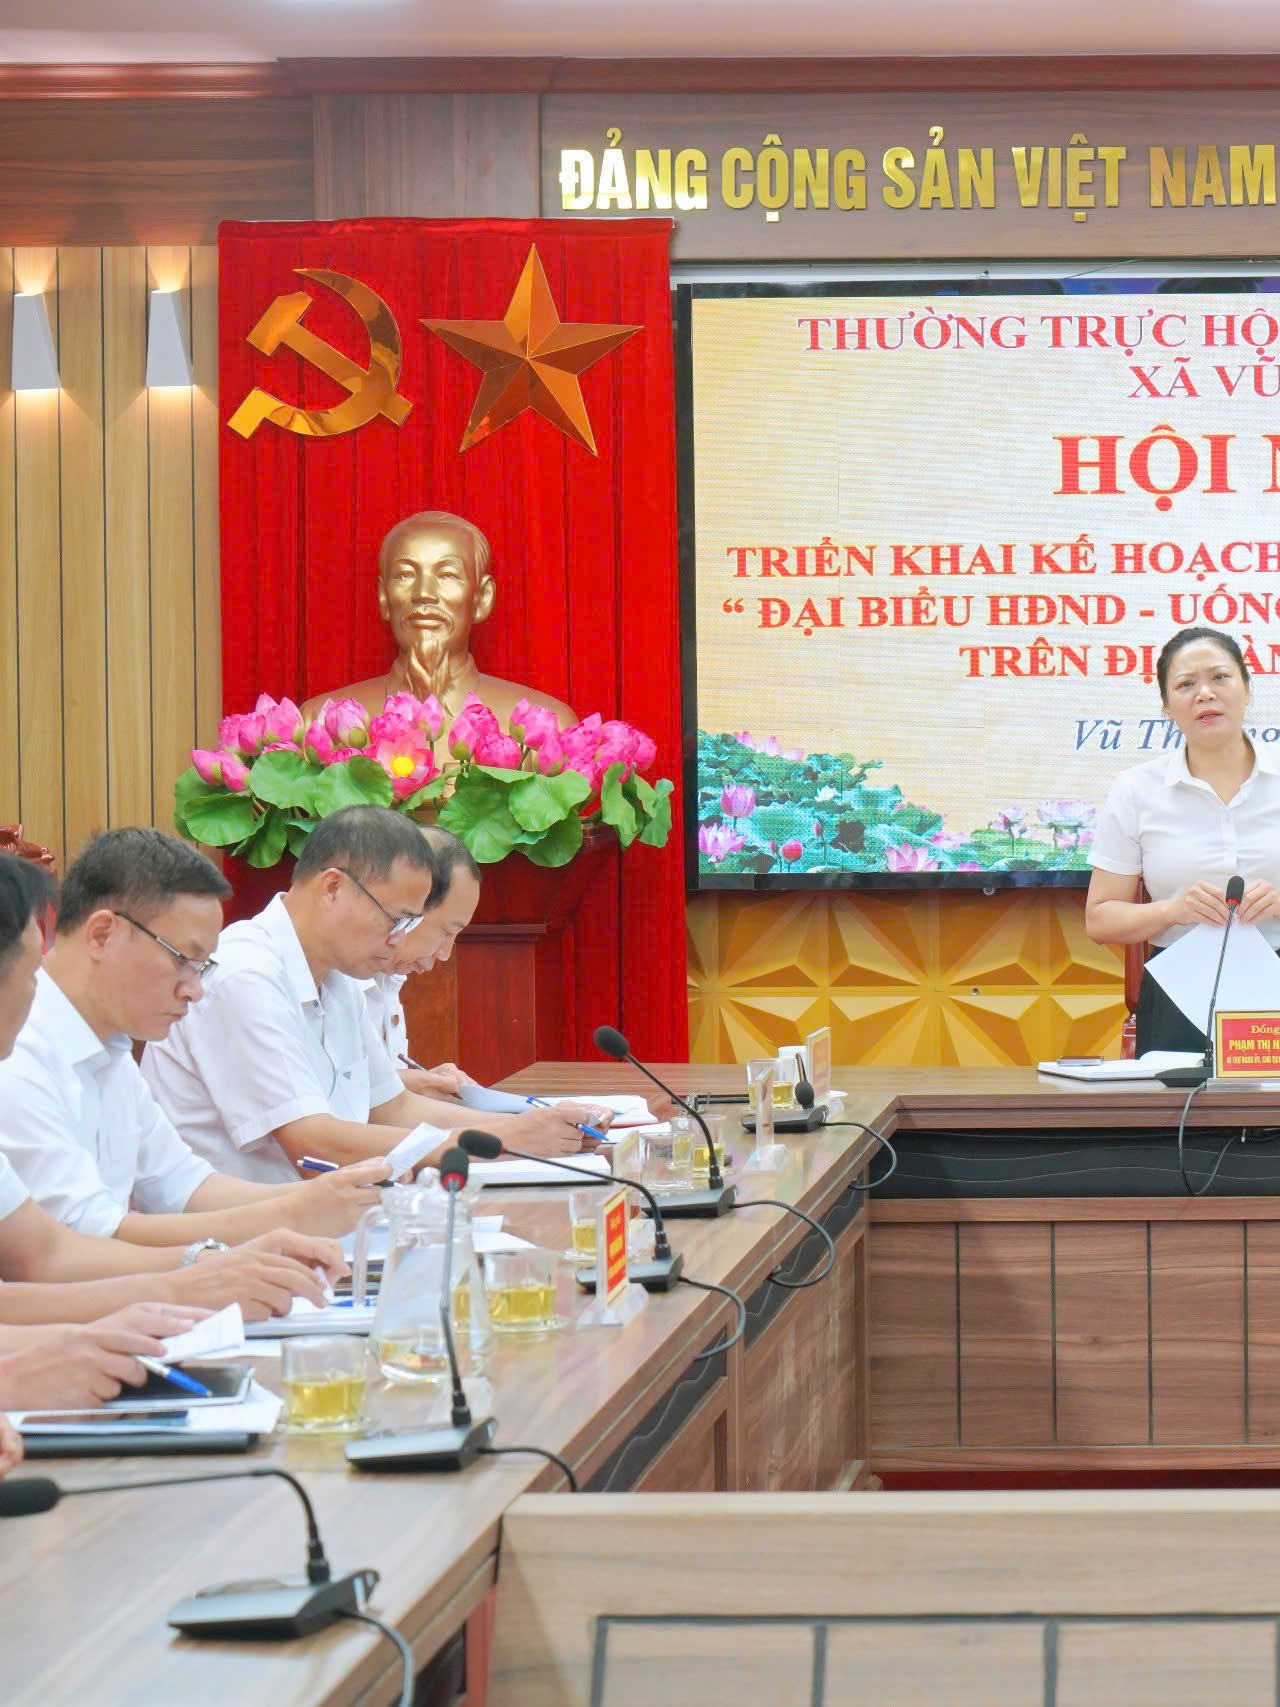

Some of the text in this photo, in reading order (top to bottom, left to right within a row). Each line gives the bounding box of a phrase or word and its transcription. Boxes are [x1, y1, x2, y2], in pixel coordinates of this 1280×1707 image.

[558, 127, 709, 211] ĐẢNG
[721, 133, 869, 223] CỘNG
[882, 125, 998, 210] SẢN
[1011, 133, 1127, 223] VIỆT
[1150, 145, 1277, 207] NAM
[797, 306, 1028, 351] THƯỜNG
[1041, 308, 1188, 357] TRỰC
[1127, 357, 1200, 398] XÃ
[1052, 424, 1237, 512] HỘI
[726, 537, 877, 579] TRIỂN
[889, 543, 1018, 577] KHAI
[1030, 533, 1098, 575] KẾ
[757, 597, 845, 637] ĐẠI
[858, 586, 974, 627] BIỂU
[985, 594, 1126, 626] HĐND
[959, 637, 1089, 678] TRÊN
[1104, 645, 1157, 684] ĐỊ
[1074, 718, 1123, 751] Vũ
[1228, 1039, 1255, 1053] PHẠM
[1256, 1039, 1271, 1053] THỊ
[1251, 1024, 1280, 1036] Đồng
